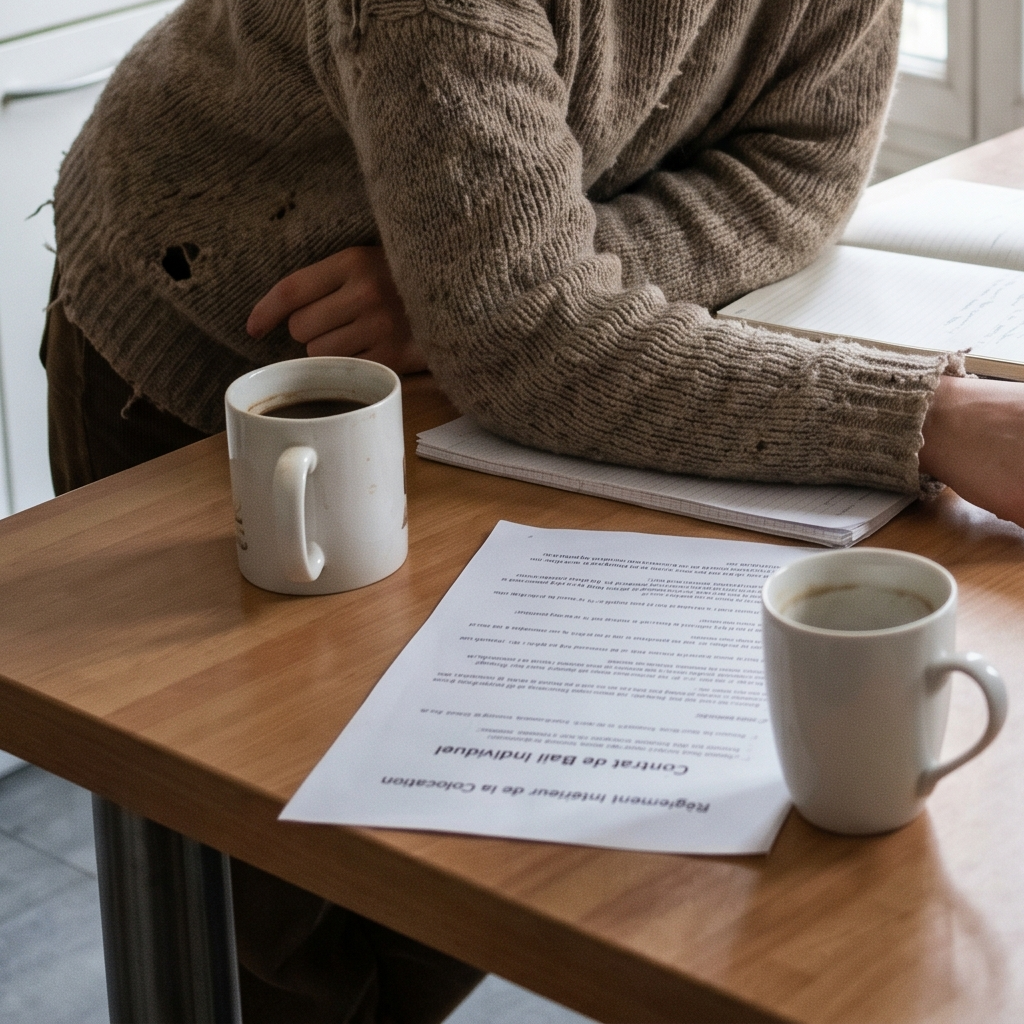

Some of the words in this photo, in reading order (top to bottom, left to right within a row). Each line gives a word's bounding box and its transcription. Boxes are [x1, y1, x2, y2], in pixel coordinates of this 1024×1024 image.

[434, 745, 533, 763] Individuel
[536, 753, 577, 766] Bail
[583, 756, 607, 768] de
[612, 760, 689, 775] Contrat
[381, 776, 476, 793] Colocation
[502, 785, 525, 796] de
